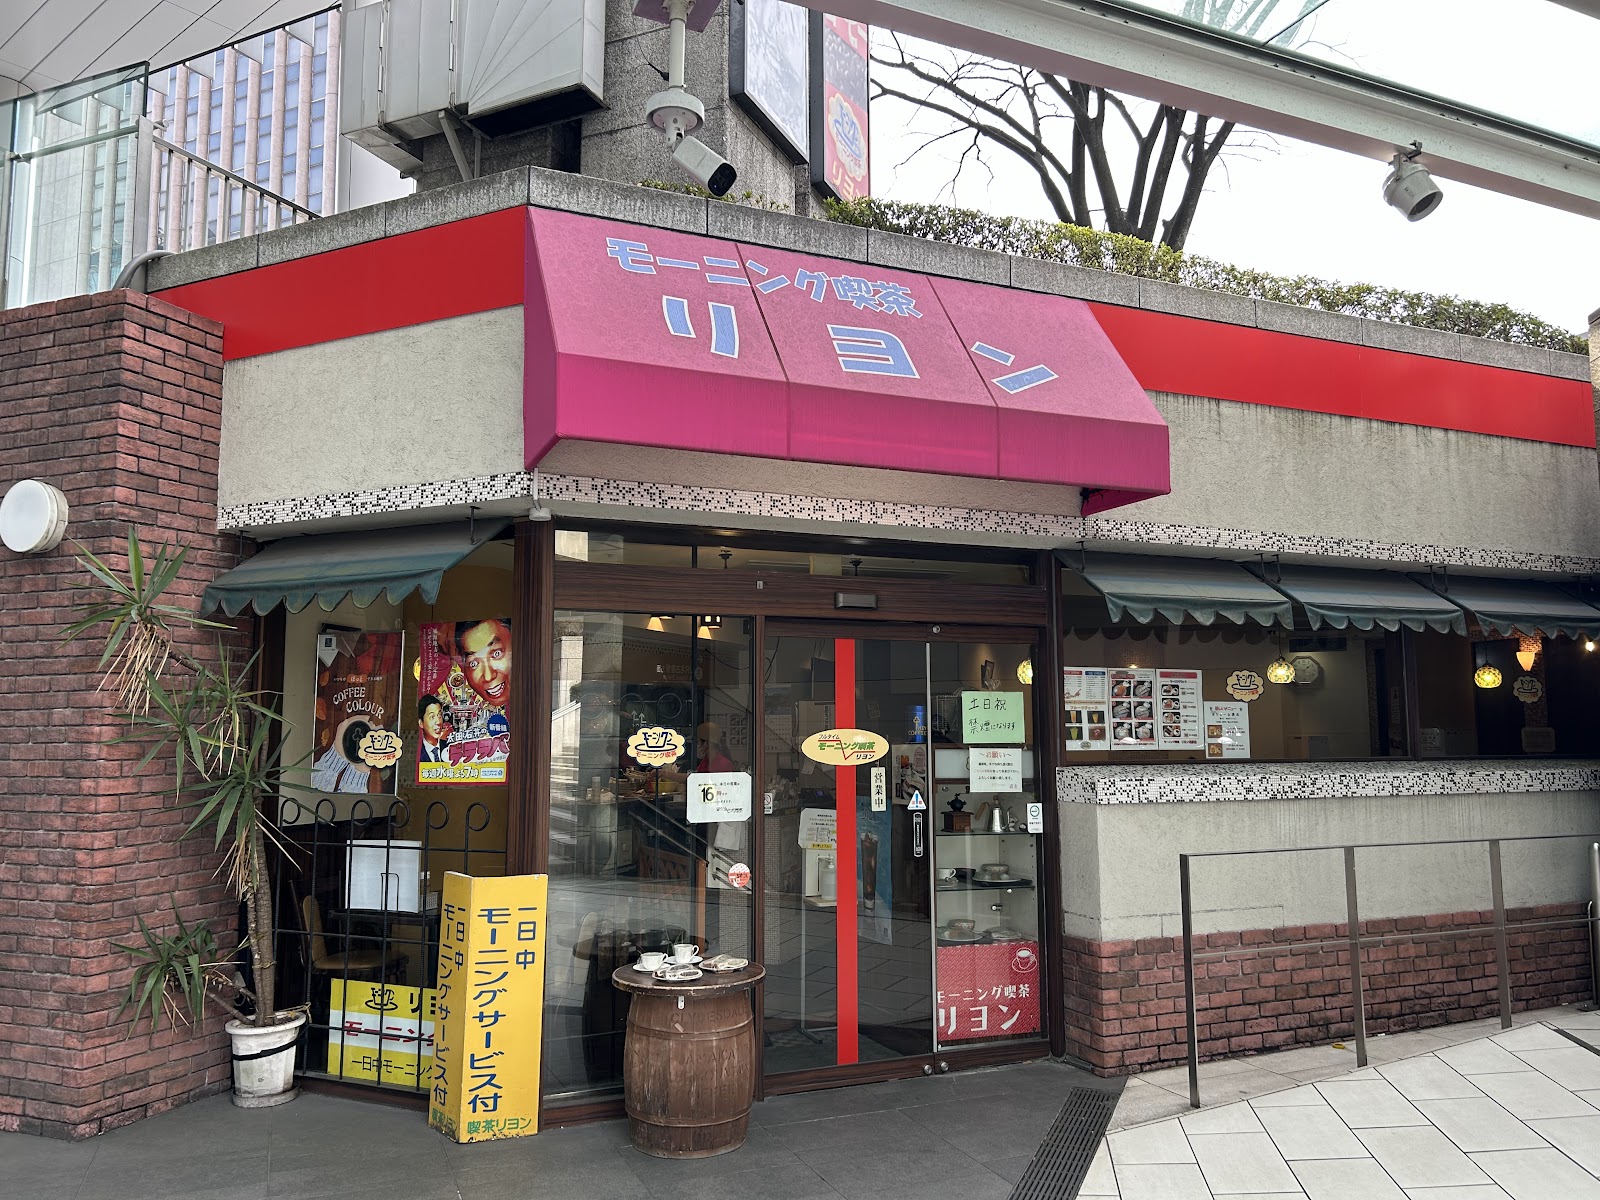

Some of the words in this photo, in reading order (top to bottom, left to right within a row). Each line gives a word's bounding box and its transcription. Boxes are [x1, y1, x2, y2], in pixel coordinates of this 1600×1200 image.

[606, 237, 922, 318] モーニング喫茶
[662, 295, 1058, 394] リヨン
[333, 687, 366, 705] COFFEE
[346, 699, 385, 720] COLOUR
[968, 718, 1016, 735] 禁煙になります
[448, 733, 510, 767] デララバ
[635, 750, 677, 760] モーニング喫茶
[818, 741, 876, 751] モーニング喫茶
[422, 765, 479, 779] 毎週水曜よる7時
[701, 786, 715, 803] 16
[874, 772, 883, 809] 営業中
[454, 907, 466, 971] 一日中
[515, 907, 538, 970] 一日中
[433, 903, 454, 1106] モーニングサービス付
[937, 983, 1031, 1004] モーニング喫茶
[467, 907, 512, 1114] モーニングサービス付
[938, 1005, 1021, 1035] リヨン
[467, 1117, 532, 1135] 喫茶リヨン
